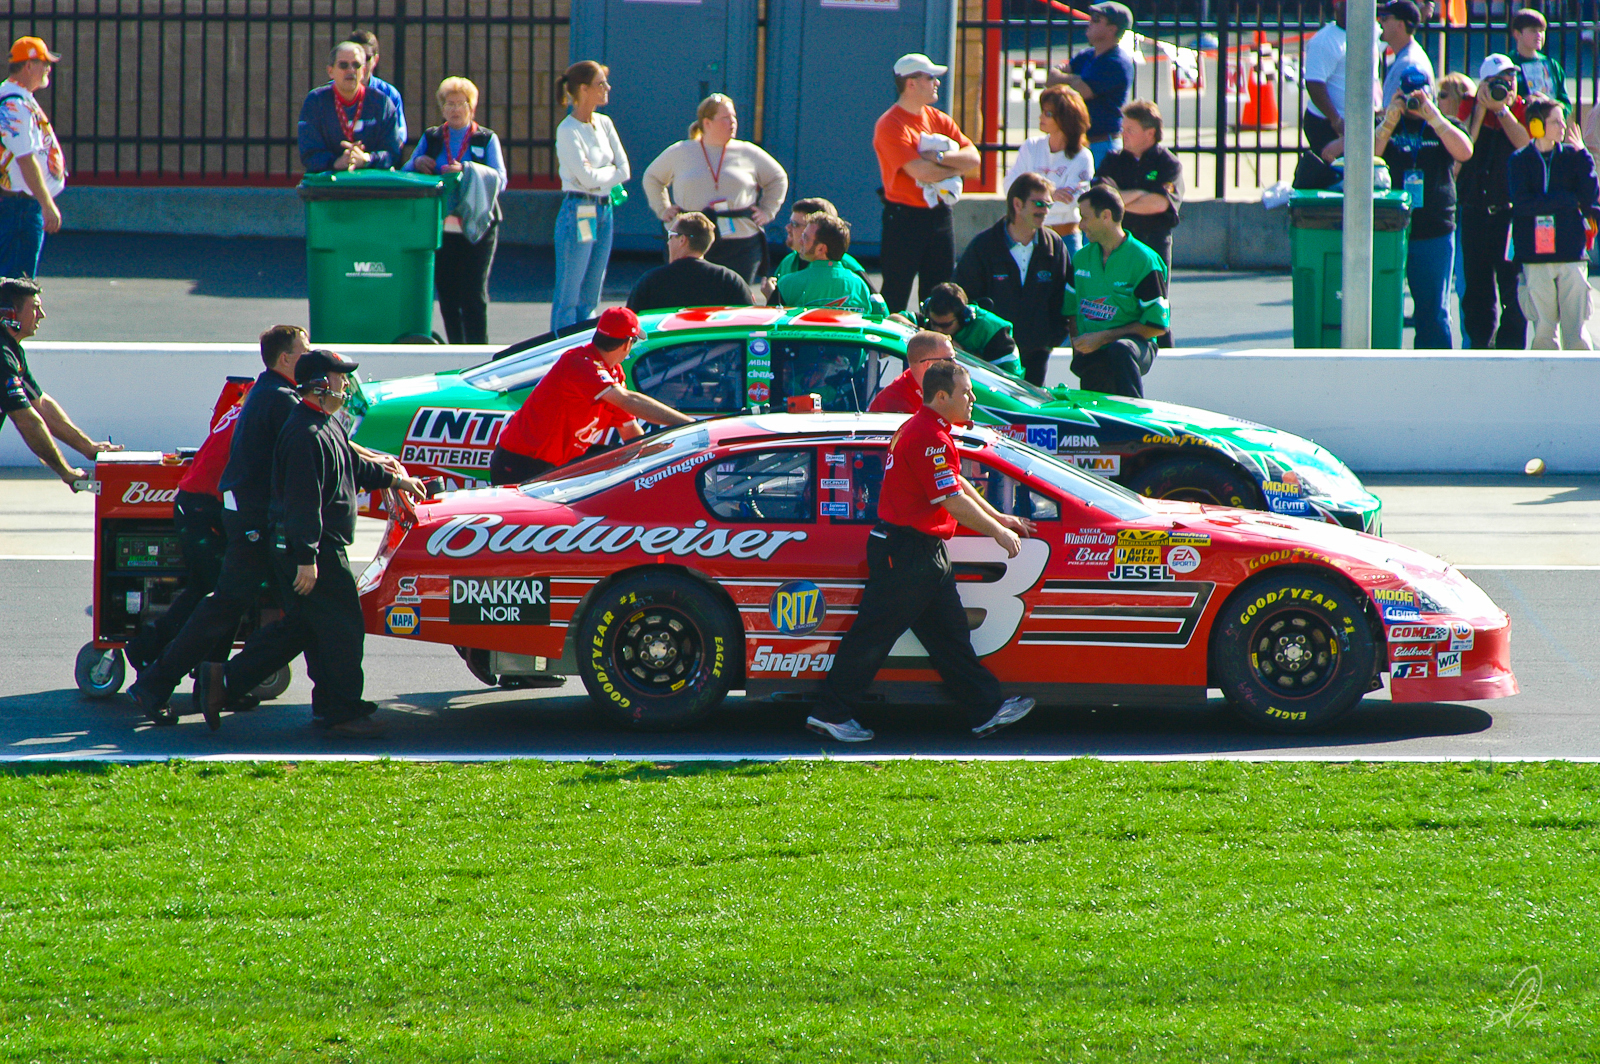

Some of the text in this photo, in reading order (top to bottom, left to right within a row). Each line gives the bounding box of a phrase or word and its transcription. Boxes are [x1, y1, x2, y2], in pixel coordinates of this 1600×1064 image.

[1027, 427, 1057, 451] USG
[1059, 435, 1100, 447] MBNA
[403, 446, 491, 466] BATTERIE
[925, 444, 947, 457] Bud
[1077, 458, 1115, 469] WM
[634, 451, 716, 492] Remington
[121, 481, 180, 504] Bud
[1262, 480, 1299, 494] MOOG
[1272, 498, 1305, 510] CLEVITE
[426, 514, 808, 561] Budweiser
[1064, 533, 1116, 545] Winston Cup
[1075, 547, 1113, 561] Bud
[1173, 549, 1196, 560] EA
[1109, 566, 1174, 580] JESEL
[453, 580, 546, 604] DRAKKAR
[1374, 589, 1414, 602] MOOG
[480, 607, 520, 622] NOIR
[776, 589, 820, 630] RITZ
[1240, 587, 1355, 634] GOODYEAR #1
[391, 614, 414, 627] NAPA
[1392, 627, 1436, 637] COMP
[592, 592, 637, 708] GOODYEAR #1
[712, 636, 724, 678] EAGLE
[1394, 646, 1433, 657] Edelbrock
[1439, 653, 1459, 669] WIX
[1265, 706, 1307, 720] EAGLE
